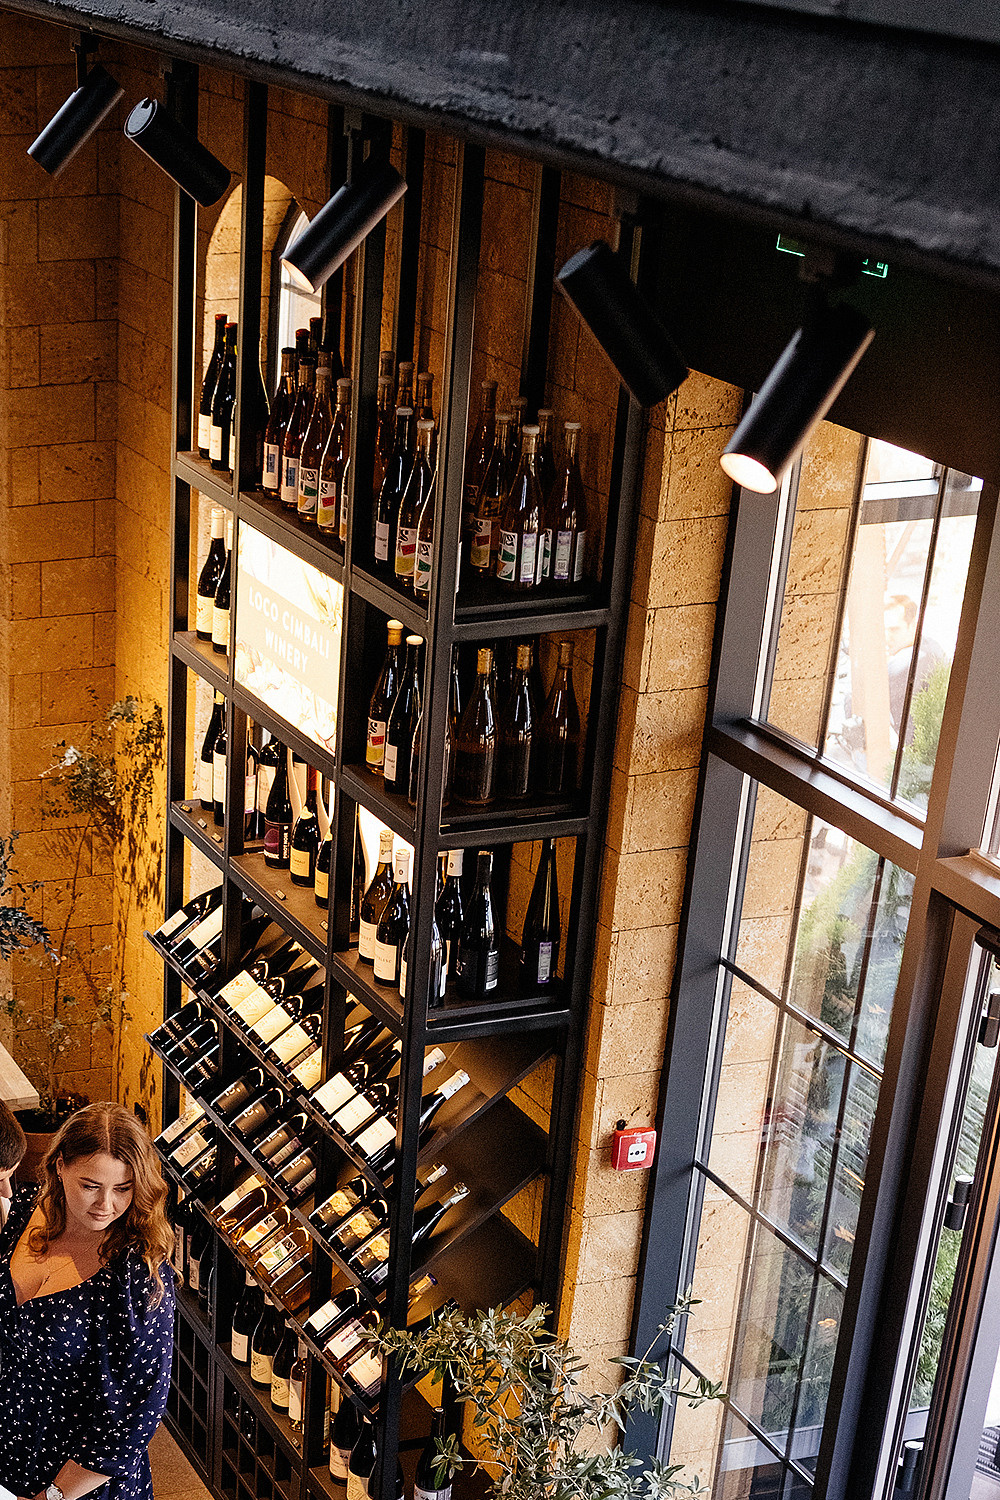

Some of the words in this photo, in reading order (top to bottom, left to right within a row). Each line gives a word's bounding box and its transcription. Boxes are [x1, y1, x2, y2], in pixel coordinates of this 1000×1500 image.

[248, 586, 279, 621] LOCO
[281, 609, 330, 660] CIMBALI
[264, 627, 309, 675] WINERY
